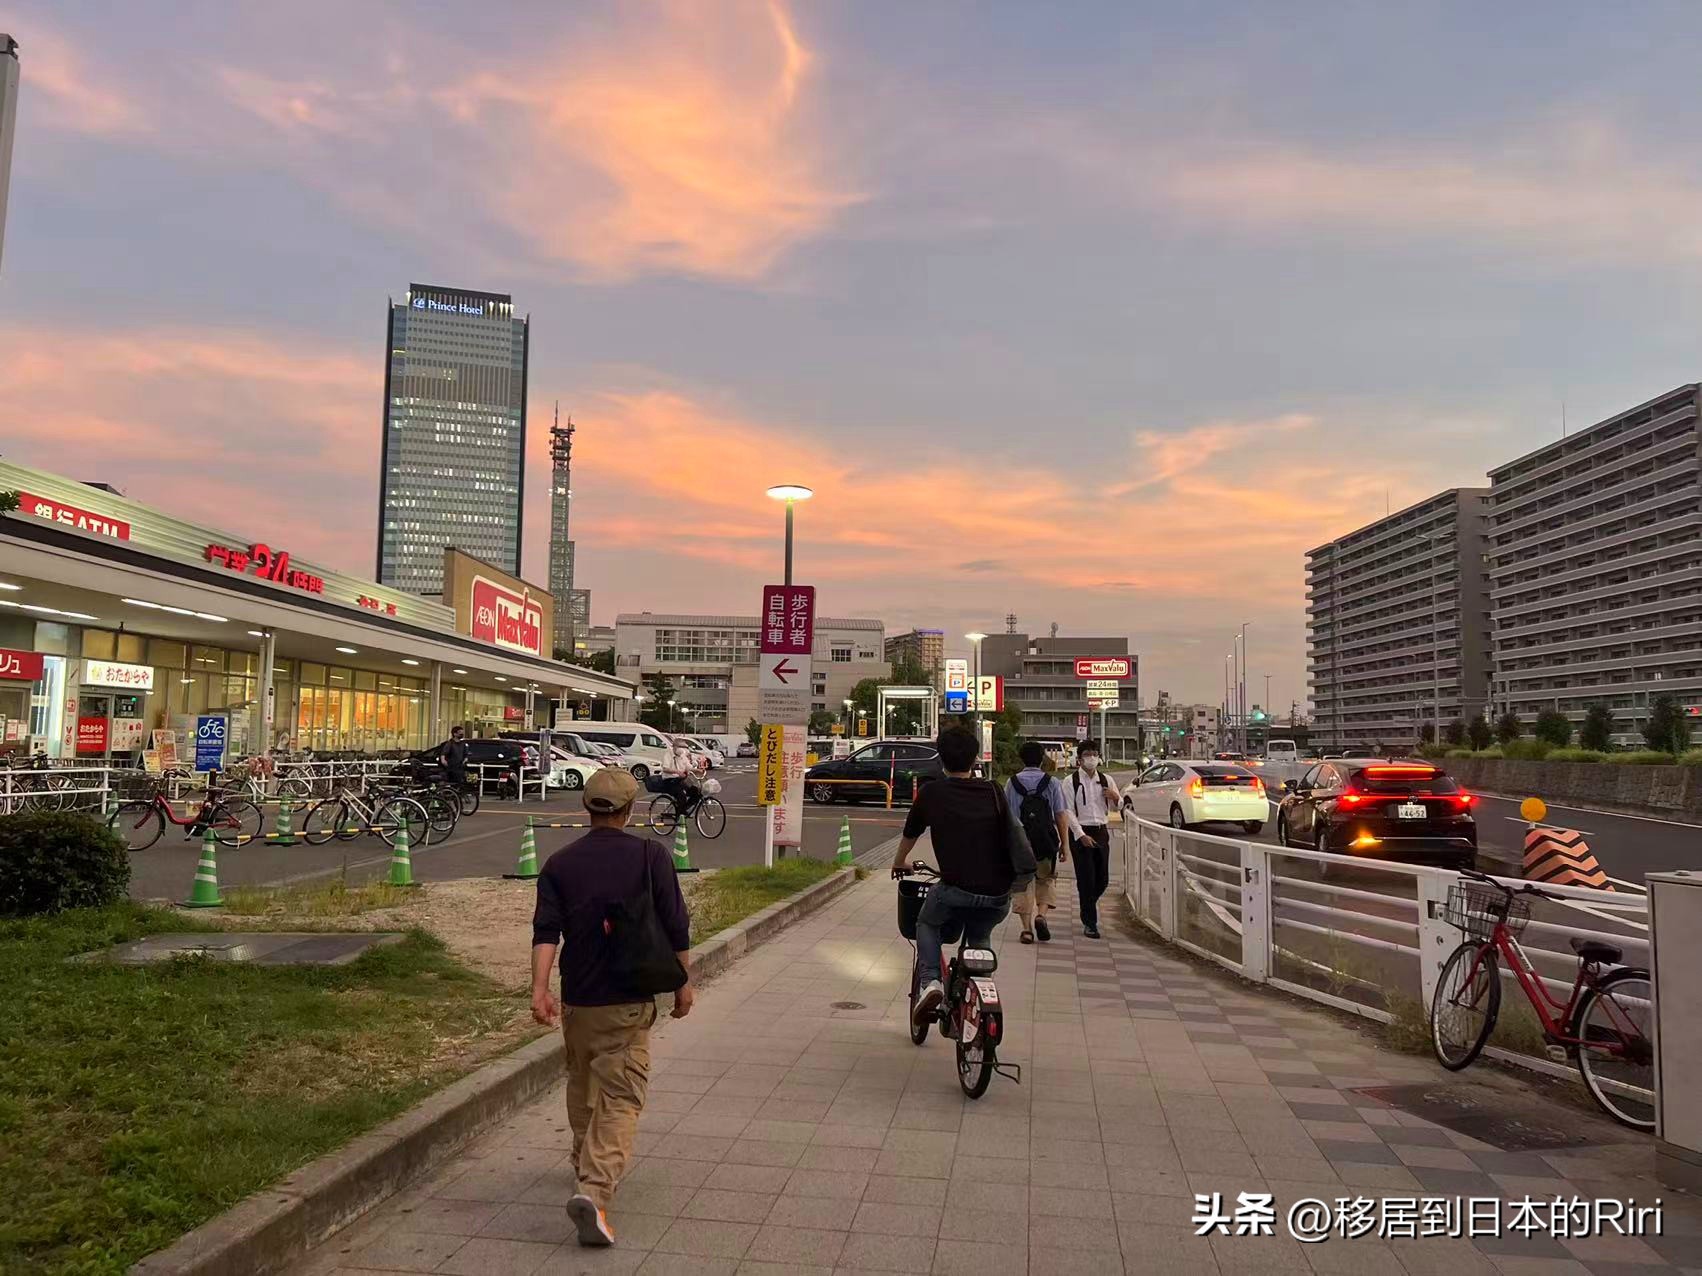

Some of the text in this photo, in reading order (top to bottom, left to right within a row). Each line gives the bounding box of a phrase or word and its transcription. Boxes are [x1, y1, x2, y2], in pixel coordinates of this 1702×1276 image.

[428, 300, 483, 315] Prince Hotel
[497, 591, 538, 651] MaxValu
[767, 594, 785, 645] 自転車
[789, 594, 808, 646] 歩行者
[106, 666, 150, 684] おたからや
[1093, 660, 1124, 672] MaxValu
[982, 681, 992, 695] P
[765, 728, 777, 802] とびだし注意
